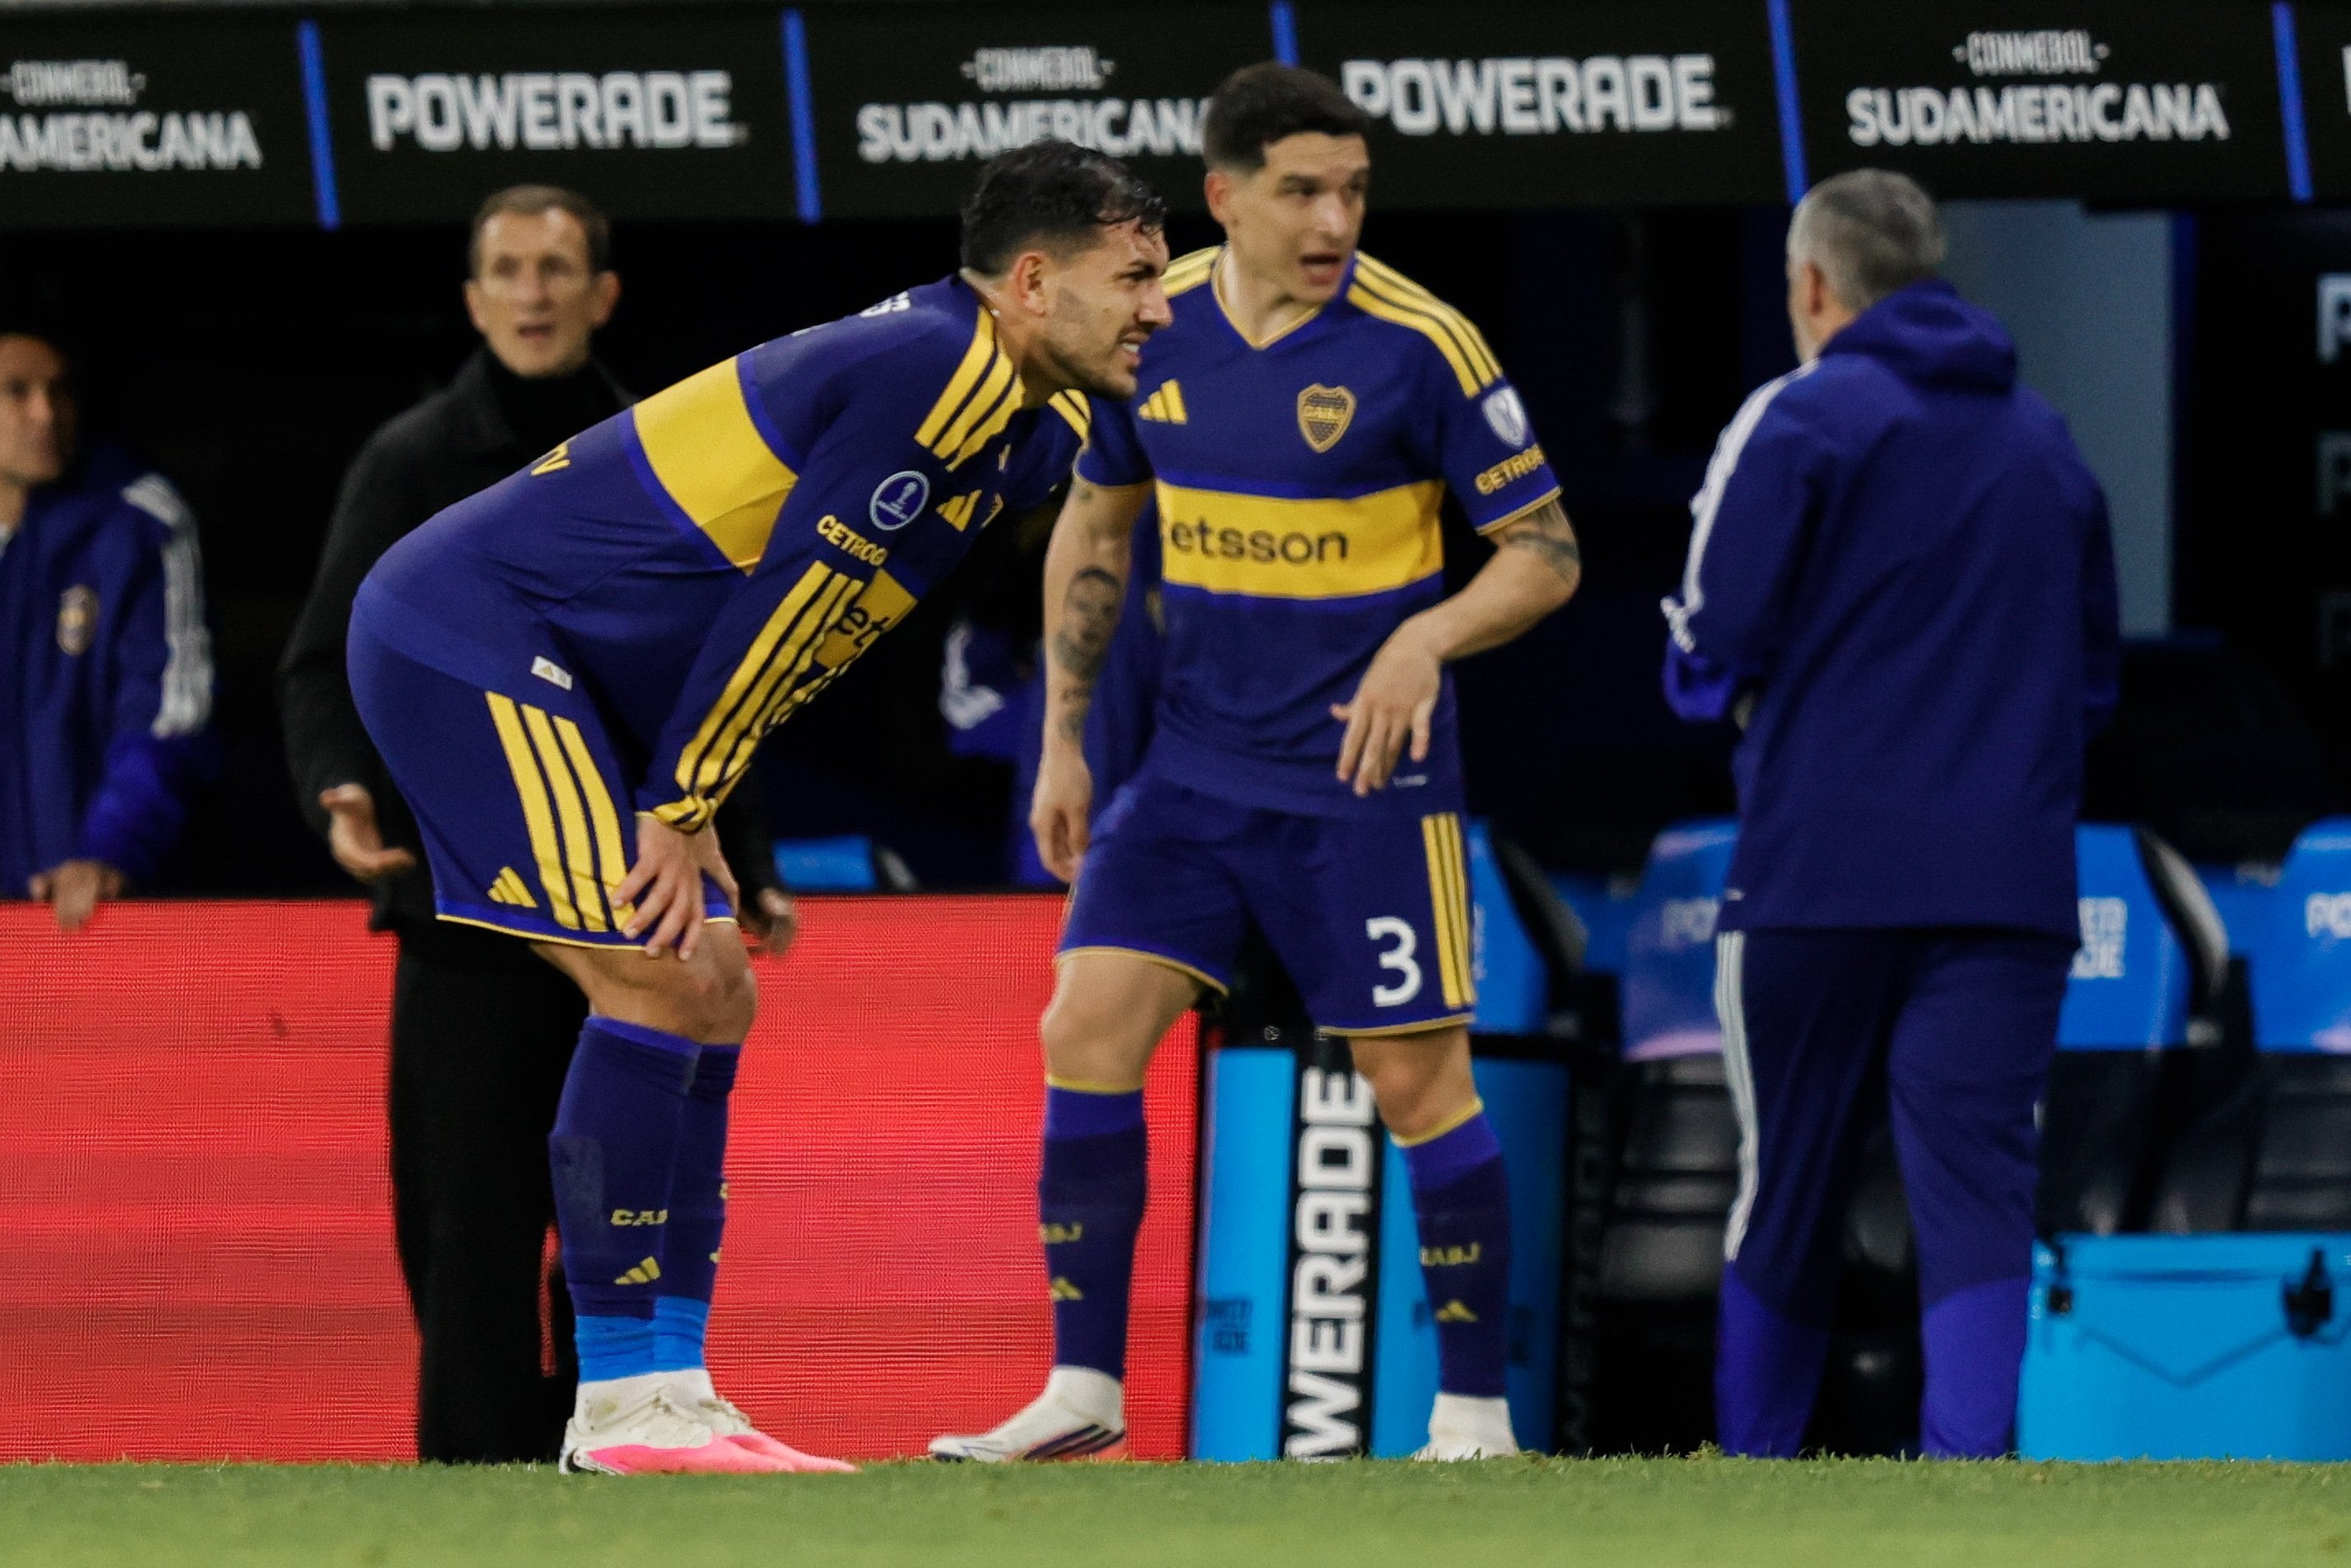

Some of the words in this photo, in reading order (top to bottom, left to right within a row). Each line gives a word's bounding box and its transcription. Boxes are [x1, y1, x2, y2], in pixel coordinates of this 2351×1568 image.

[366, 71, 733, 151] POWERADE
[1341, 54, 1715, 136] POWERADE
[1846, 83, 2231, 147] SUDAMERICANA
[1365, 915, 1423, 1008] 3
[1284, 1066, 1375, 1463] WERADE
